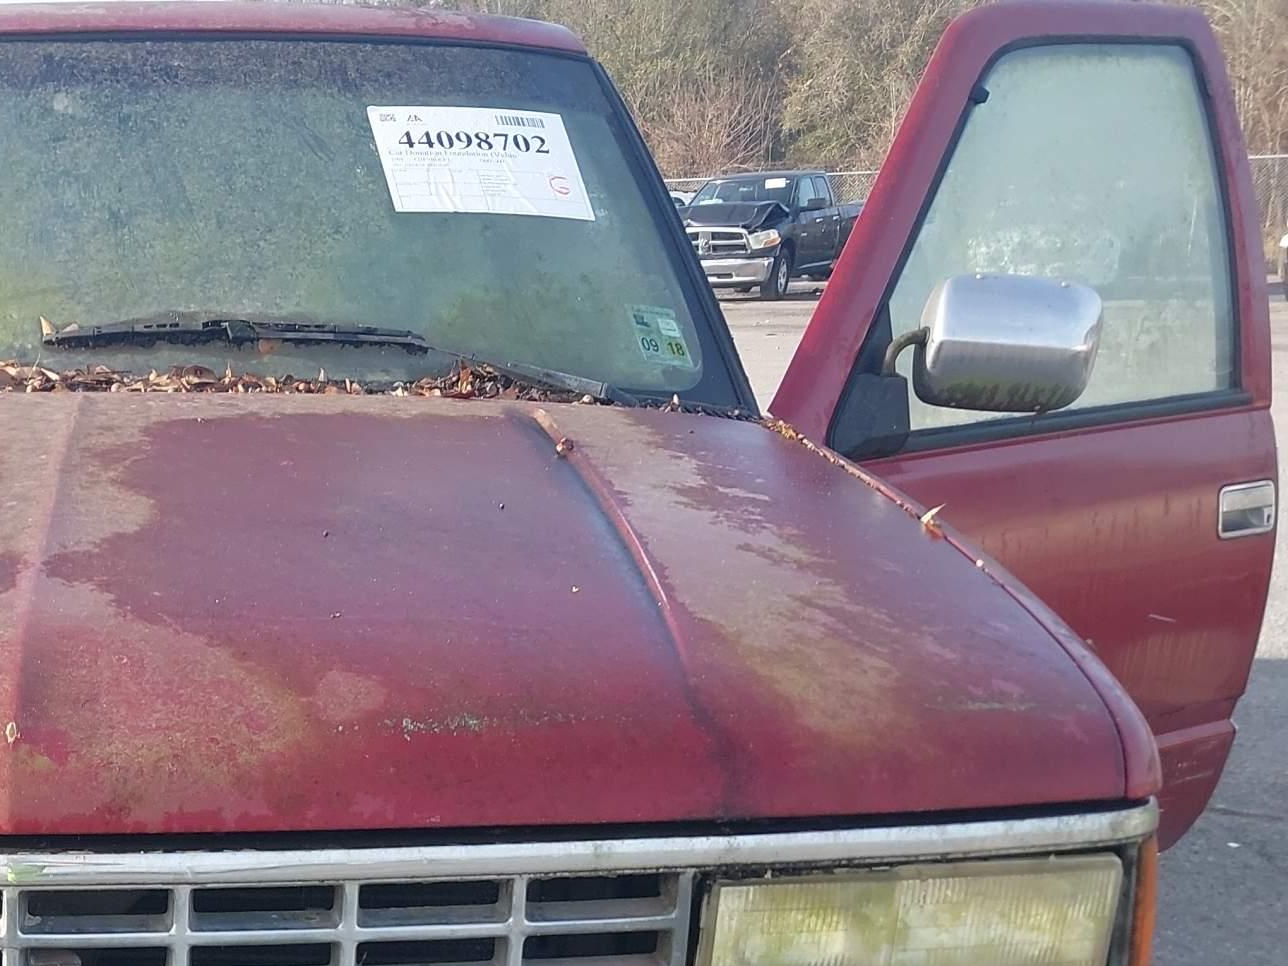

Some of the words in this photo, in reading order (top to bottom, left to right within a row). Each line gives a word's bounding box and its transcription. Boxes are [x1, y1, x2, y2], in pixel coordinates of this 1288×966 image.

[398, 130, 550, 154] 44098702
[641, 337, 659, 352] 09
[667, 342, 685, 356] 18
